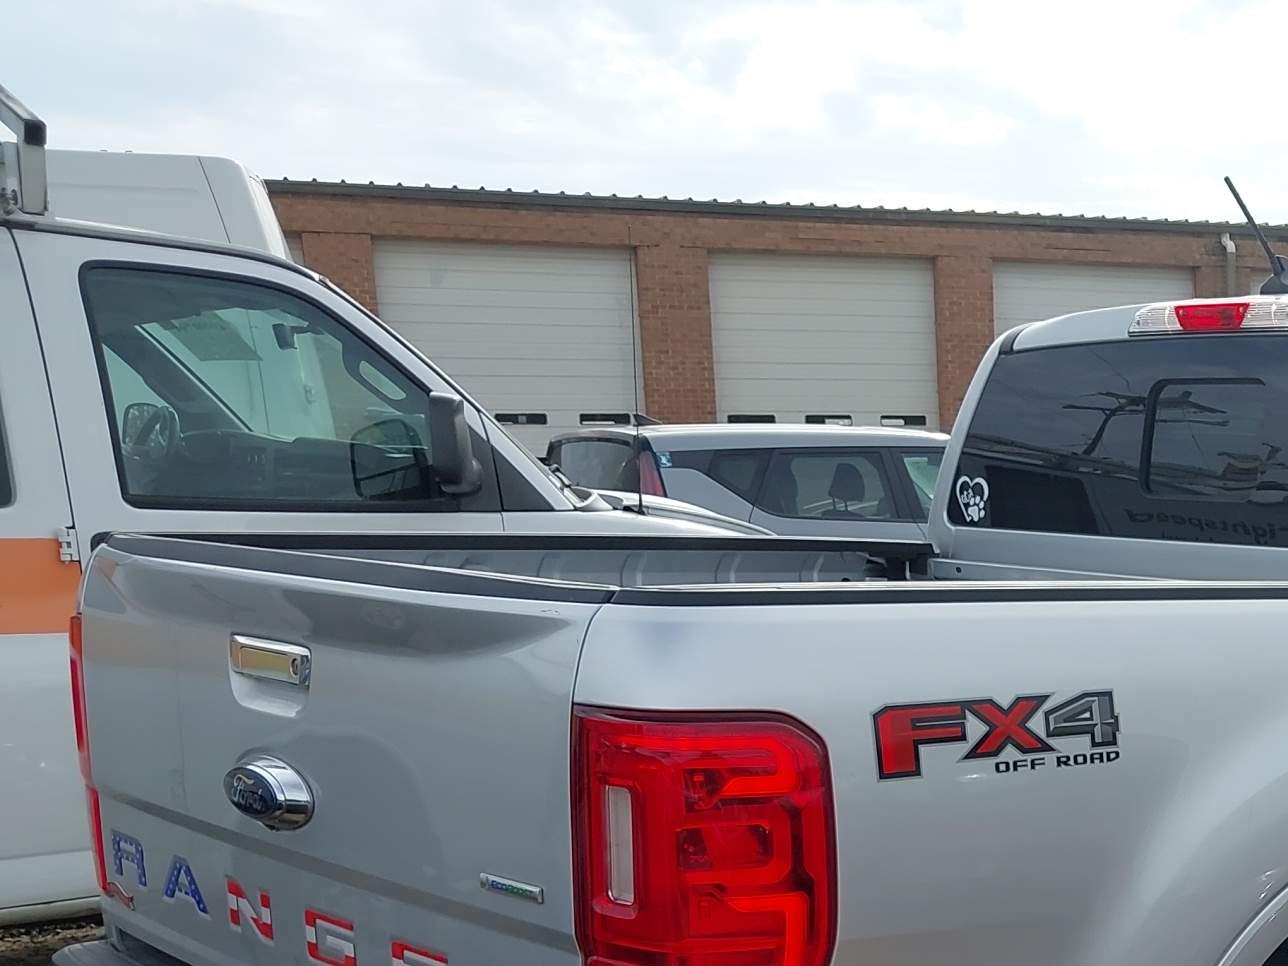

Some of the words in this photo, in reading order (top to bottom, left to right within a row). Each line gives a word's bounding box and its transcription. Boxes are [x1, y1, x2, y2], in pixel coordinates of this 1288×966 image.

[872, 688, 1121, 781] FX4
[995, 757, 1046, 774] OFF
[1056, 751, 1121, 768] ROAD
